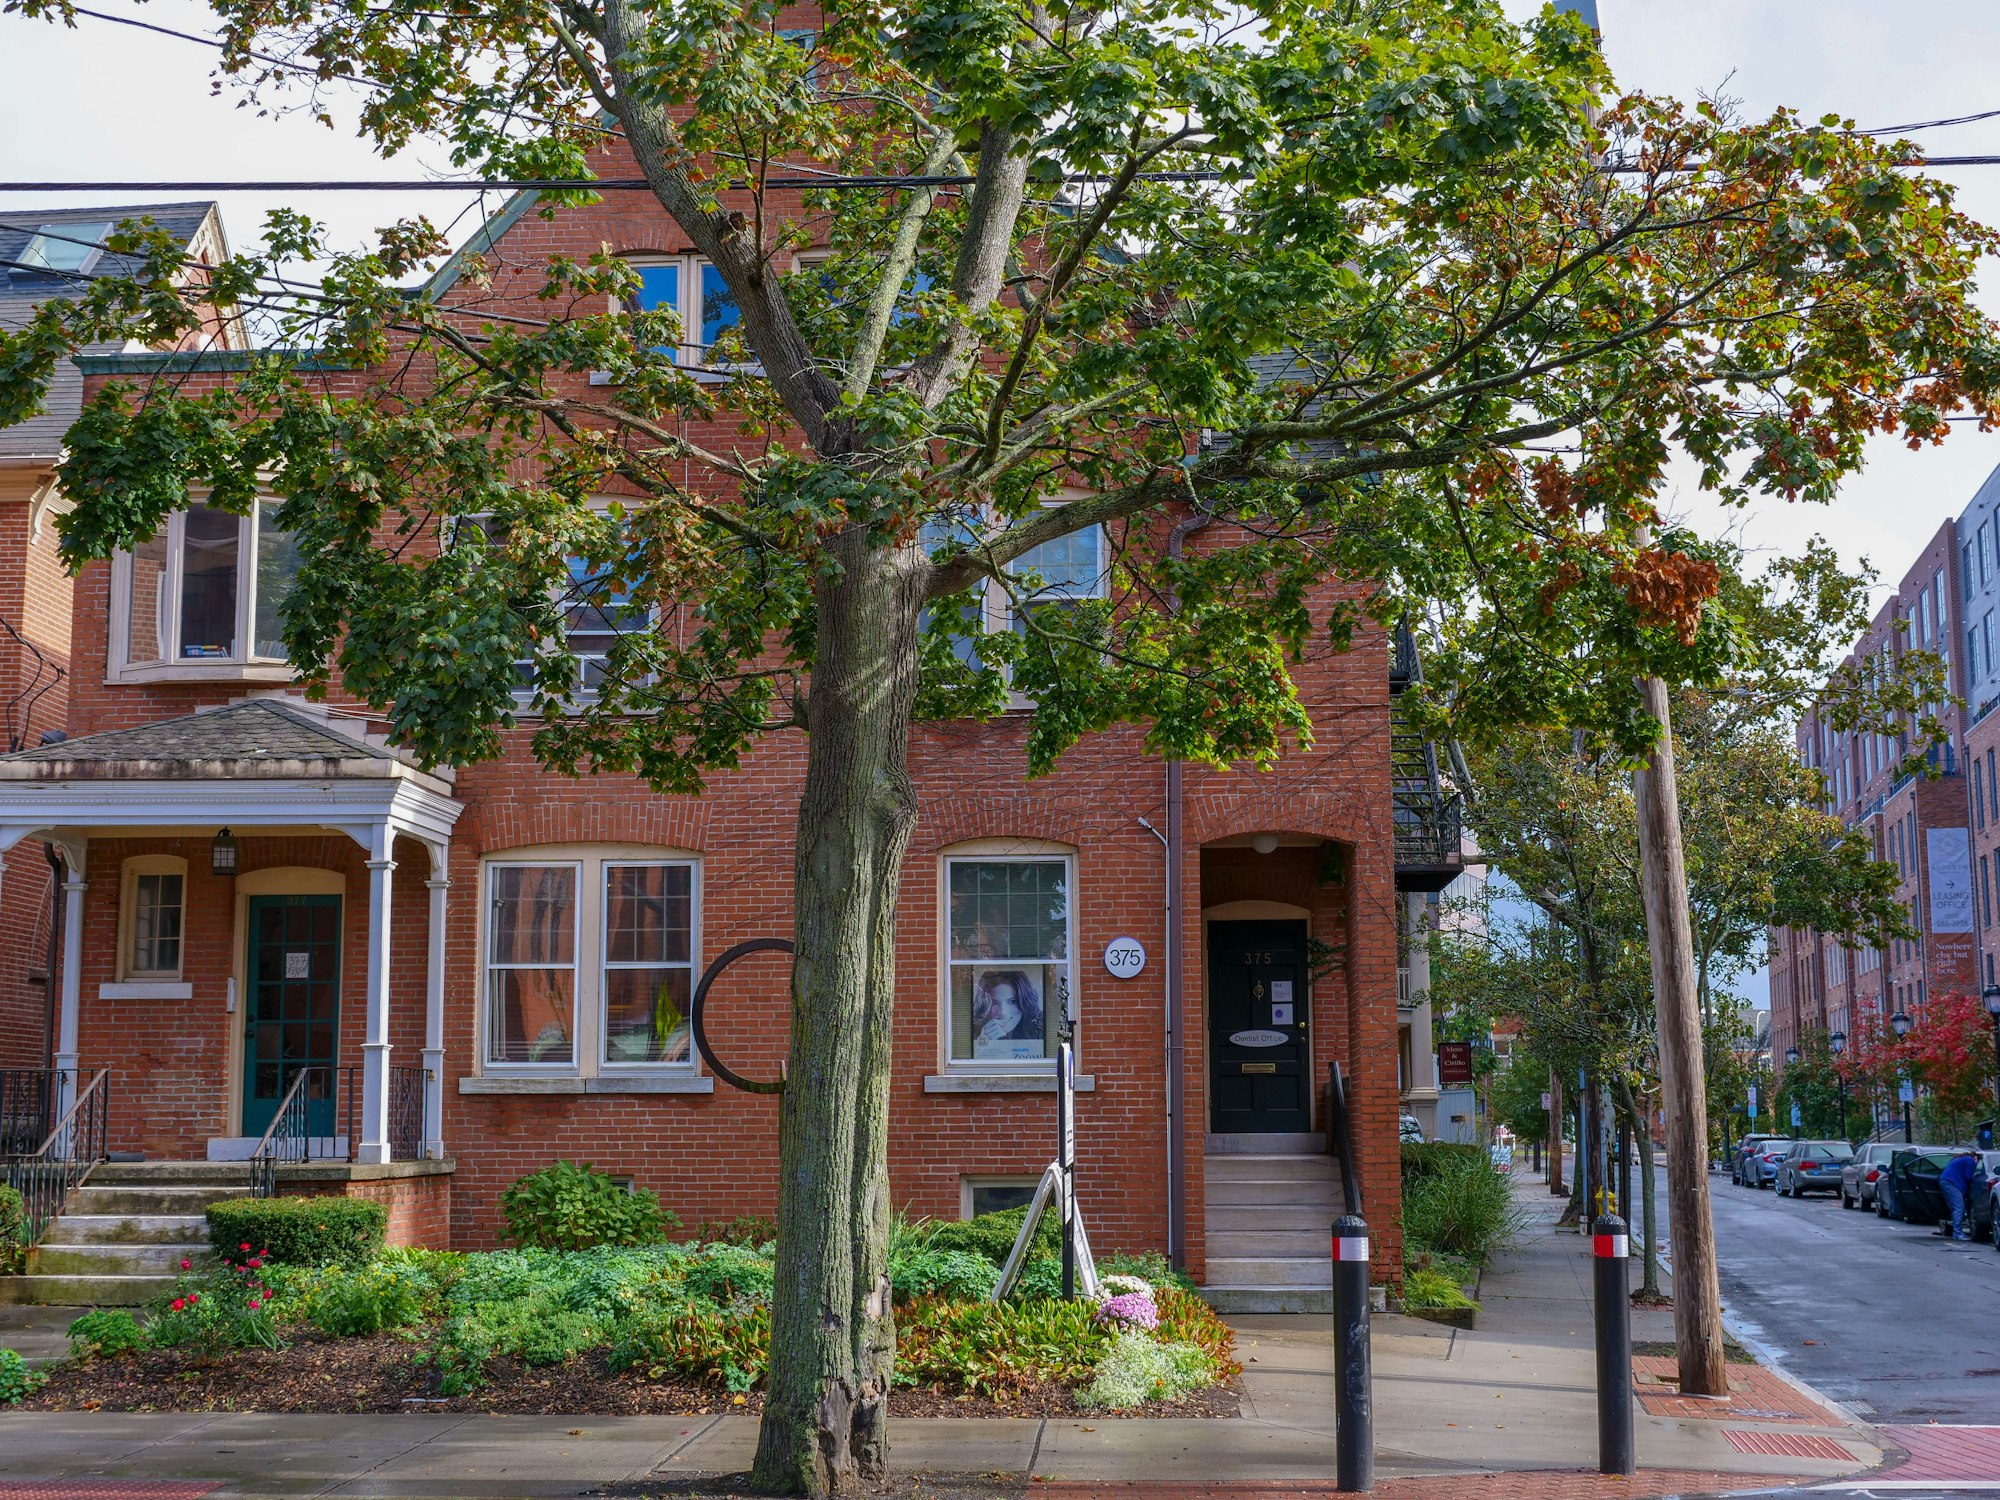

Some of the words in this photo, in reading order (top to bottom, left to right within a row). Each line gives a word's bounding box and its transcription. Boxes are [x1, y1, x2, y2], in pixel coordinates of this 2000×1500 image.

[1933, 892, 1969, 900] LEASING
[1936, 901, 1967, 909] OFFICE
[1110, 949, 1141, 966] 375
[1244, 952, 1271, 965] 375
[1936, 951, 1951, 959] else
[1936, 959, 1956, 967] right
